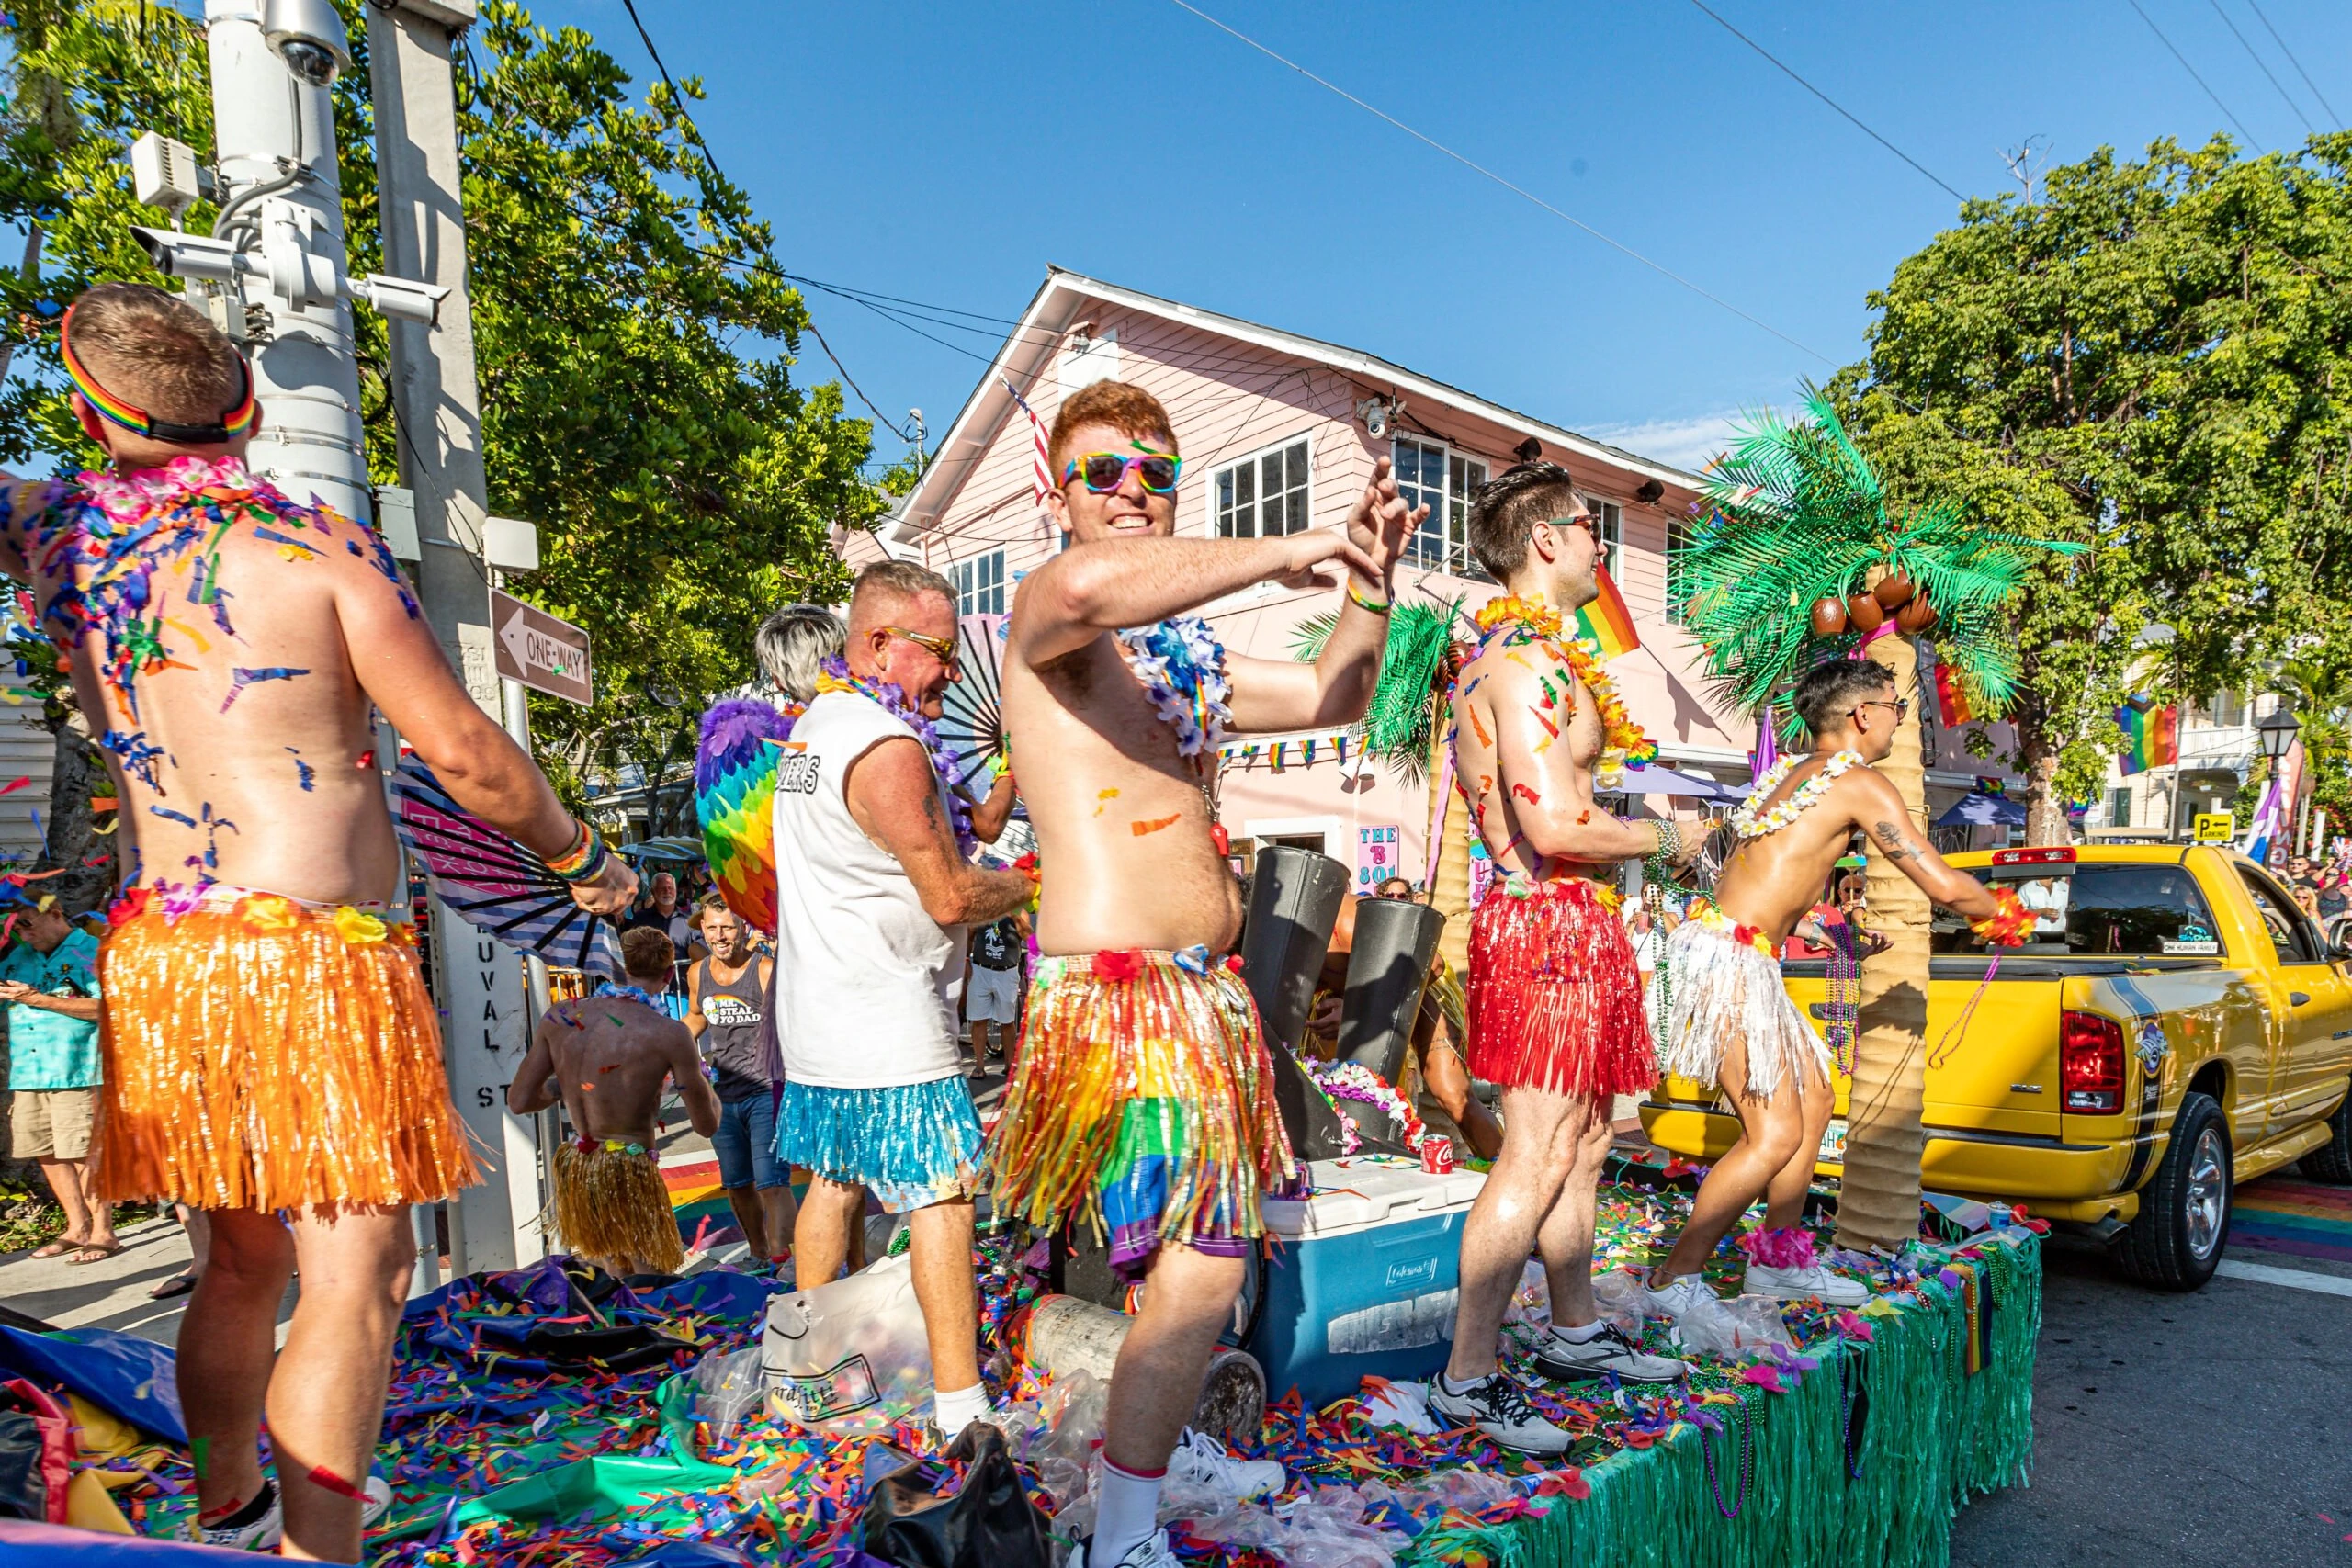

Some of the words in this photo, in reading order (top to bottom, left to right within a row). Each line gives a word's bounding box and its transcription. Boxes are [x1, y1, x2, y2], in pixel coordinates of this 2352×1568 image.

[526, 632, 553, 668] ONE
[556, 644, 581, 678] WAY
[1360, 828, 1396, 843] THE
[720, 1007, 753, 1015] STEAL
[736, 1013, 761, 1022] DAD
